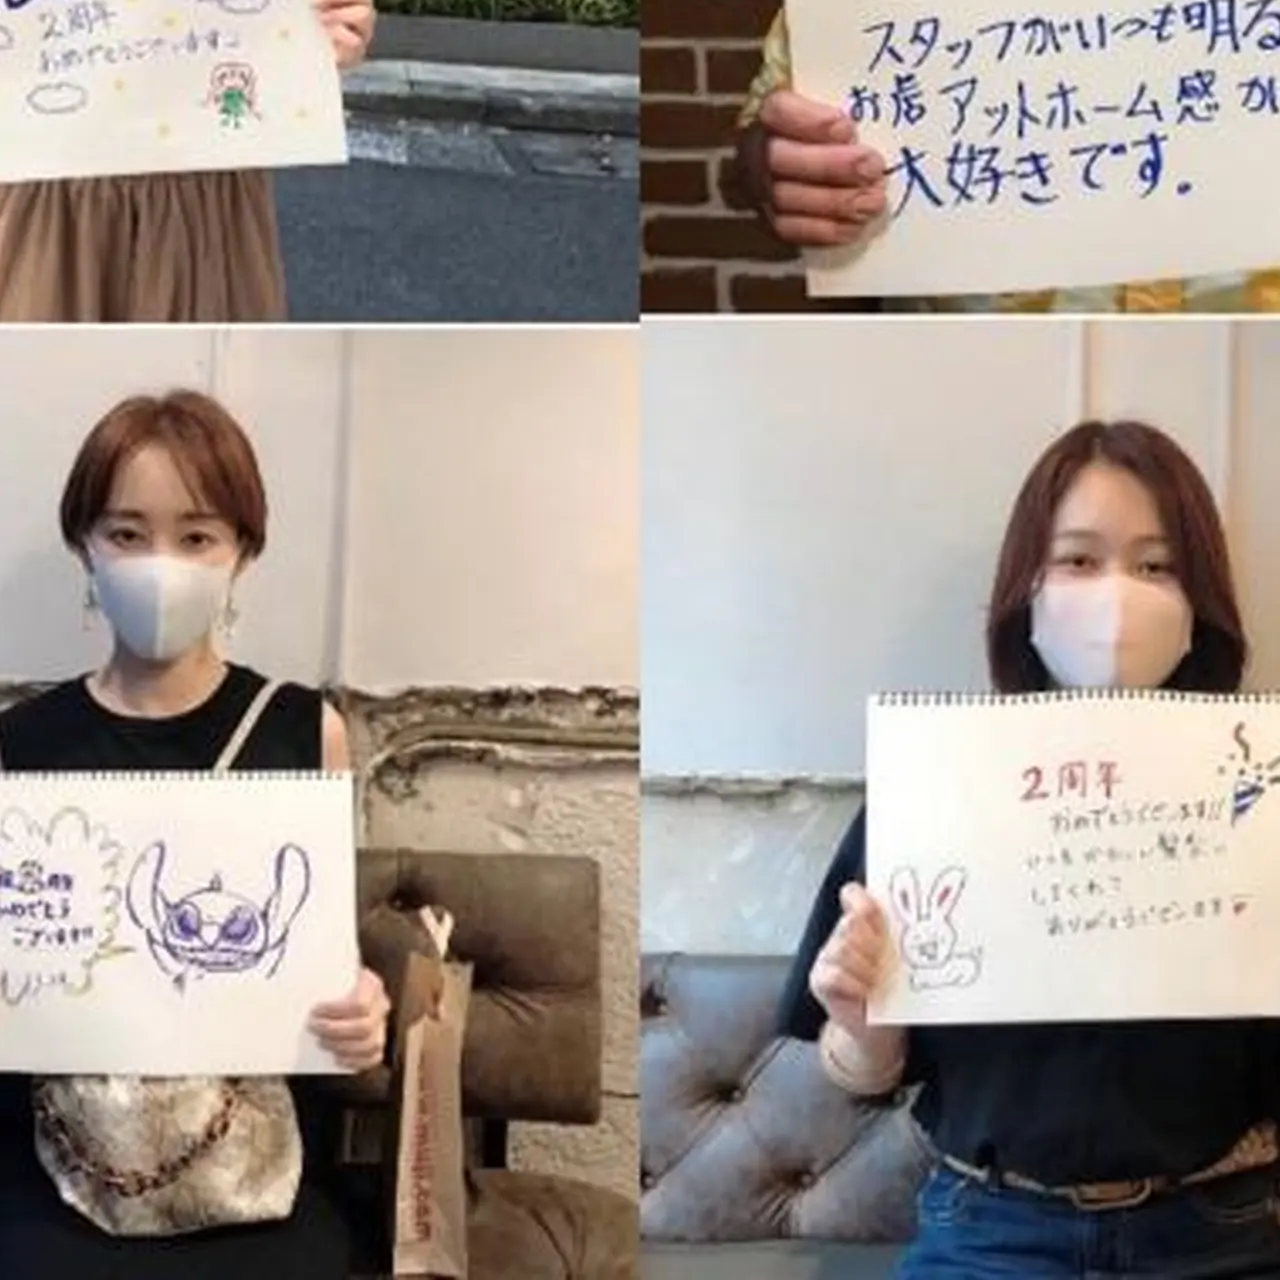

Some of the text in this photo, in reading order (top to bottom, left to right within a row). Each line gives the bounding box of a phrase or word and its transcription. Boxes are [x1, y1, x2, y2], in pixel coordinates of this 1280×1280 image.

[38, 1, 118, 40] 2周年
[881, 131, 1194, 216] 大好きです。
[1020, 760, 1123, 802] 2周年
